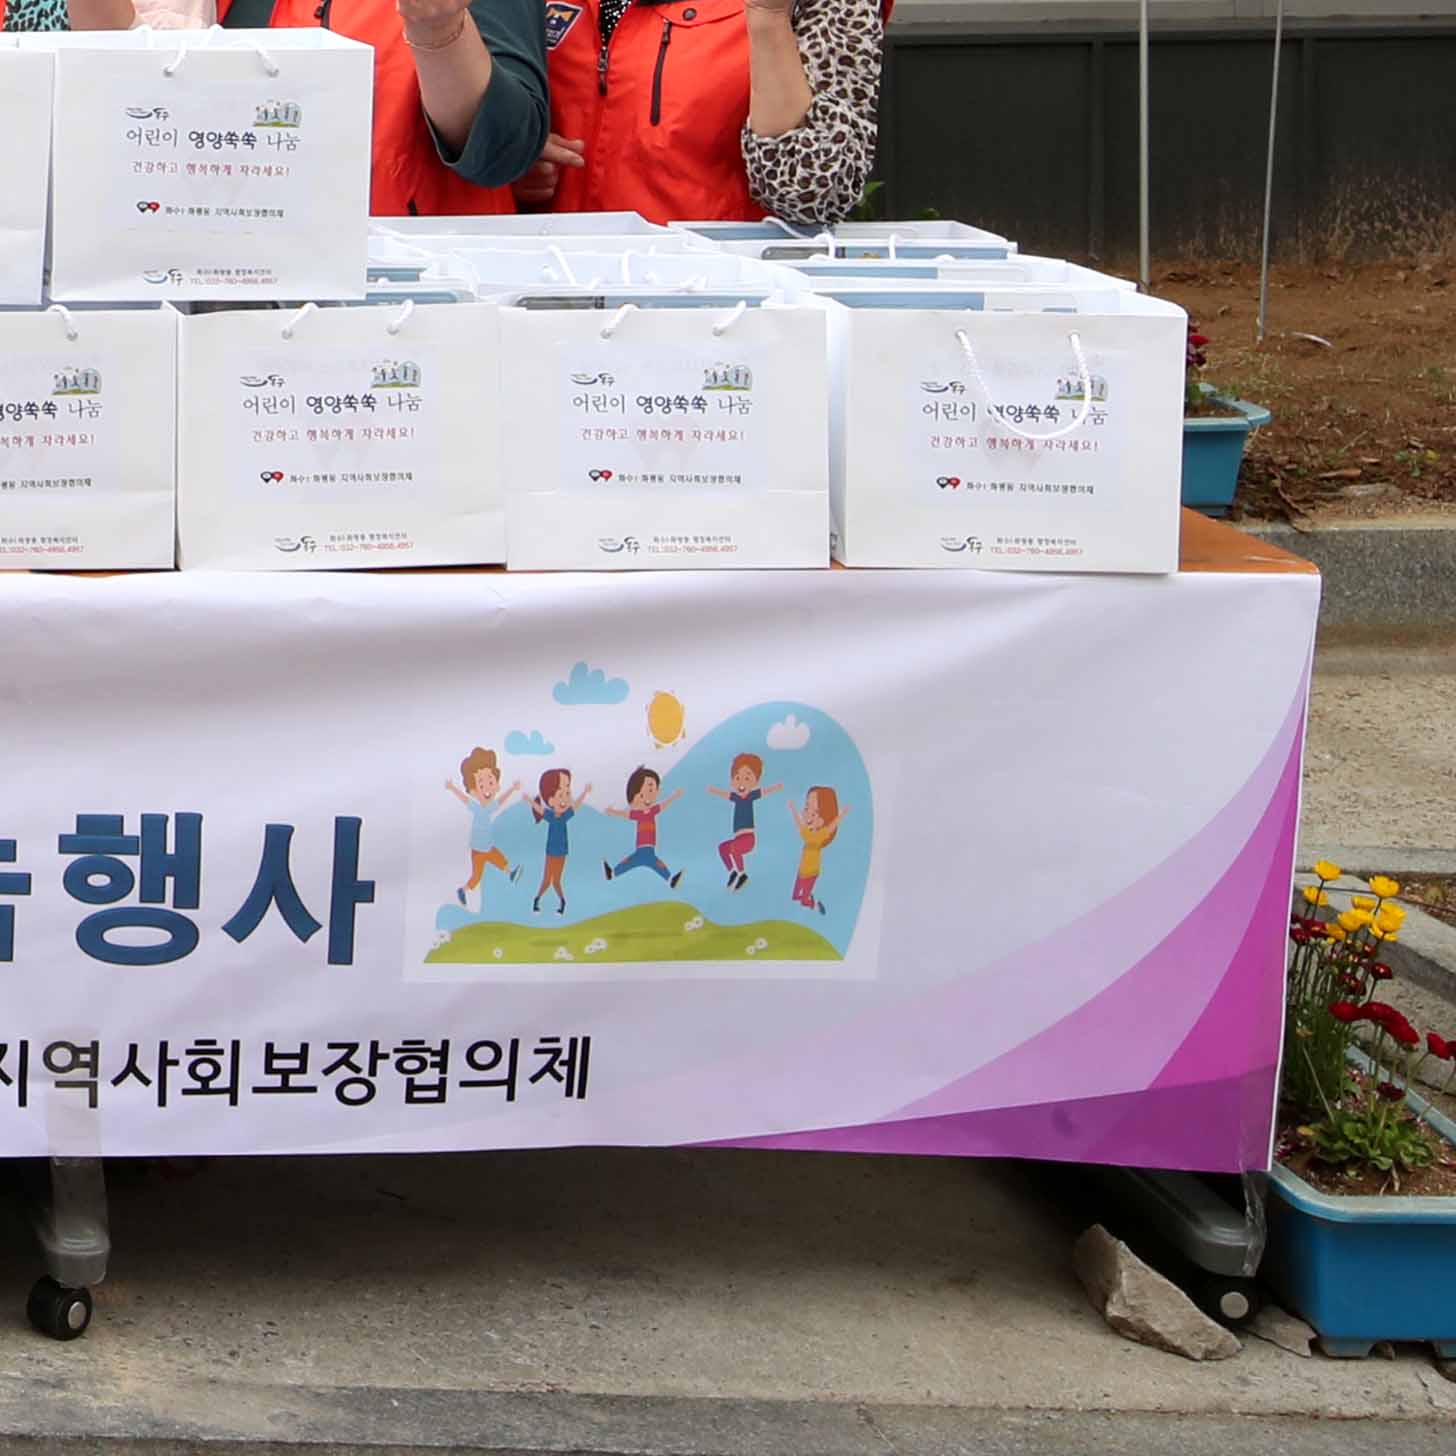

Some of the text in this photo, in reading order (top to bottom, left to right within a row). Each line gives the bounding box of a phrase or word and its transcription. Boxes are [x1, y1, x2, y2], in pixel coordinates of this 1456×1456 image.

[127, 128, 301, 151] 어린이 영양쑥쑥 나눔
[134, 162, 179, 173] 건강하고
[239, 165, 291, 177] 자라세요!
[69, 398, 103, 419] 나눔
[243, 392, 423, 417] 어린이 영양쑥쑥 나눔
[573, 395, 753, 415] 어린이 영양쑥쑥 나눔
[923, 402, 976, 422] 어린이
[42, 433, 95, 447] 자라세요!
[253, 430, 300, 442] 건강하고
[362, 426, 415, 440] 자라세요!
[583, 429, 629, 440] 건강하고
[691, 430, 745, 441] 자라세요!
[931, 436, 979, 448] 건강하고
